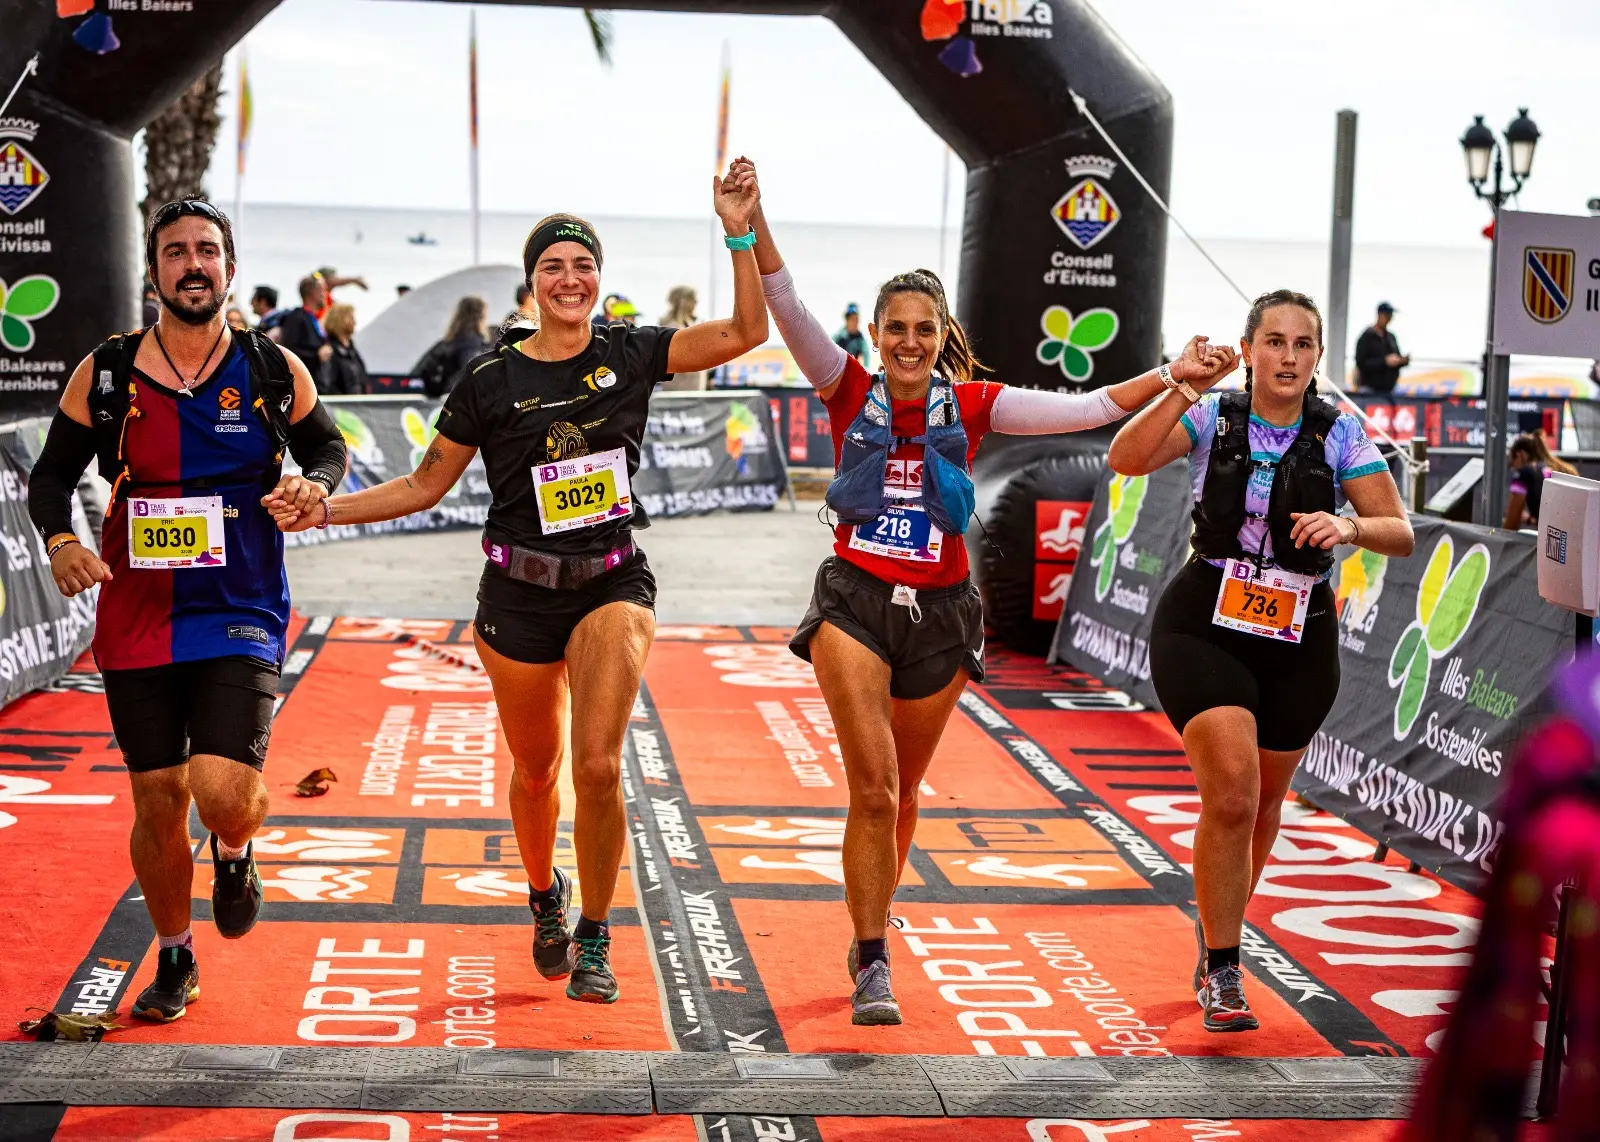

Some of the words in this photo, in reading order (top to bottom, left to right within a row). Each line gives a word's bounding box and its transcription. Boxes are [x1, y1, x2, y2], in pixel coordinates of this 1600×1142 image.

[1051, 251, 1114, 270] Consell
[1043, 269, 1117, 287] d'Eivissa
[569, 477, 588, 485] PAULA
[555, 482, 606, 511] 3029
[887, 507, 905, 516] SILVIA
[143, 527, 196, 548] 3030
[875, 515, 912, 539] 218
[1255, 586, 1274, 596] PAULA
[1241, 592, 1278, 618] 736
[1439, 656, 1470, 701] Illes
[1466, 667, 1519, 721] Balears
[1418, 711, 1503, 778] Sostenibles
[1299, 731, 1365, 796] URISME
[651, 796, 702, 869] FIREHAWK
[1075, 801, 1184, 877] FIREHAWK
[680, 889, 747, 995] FIREHAWK
